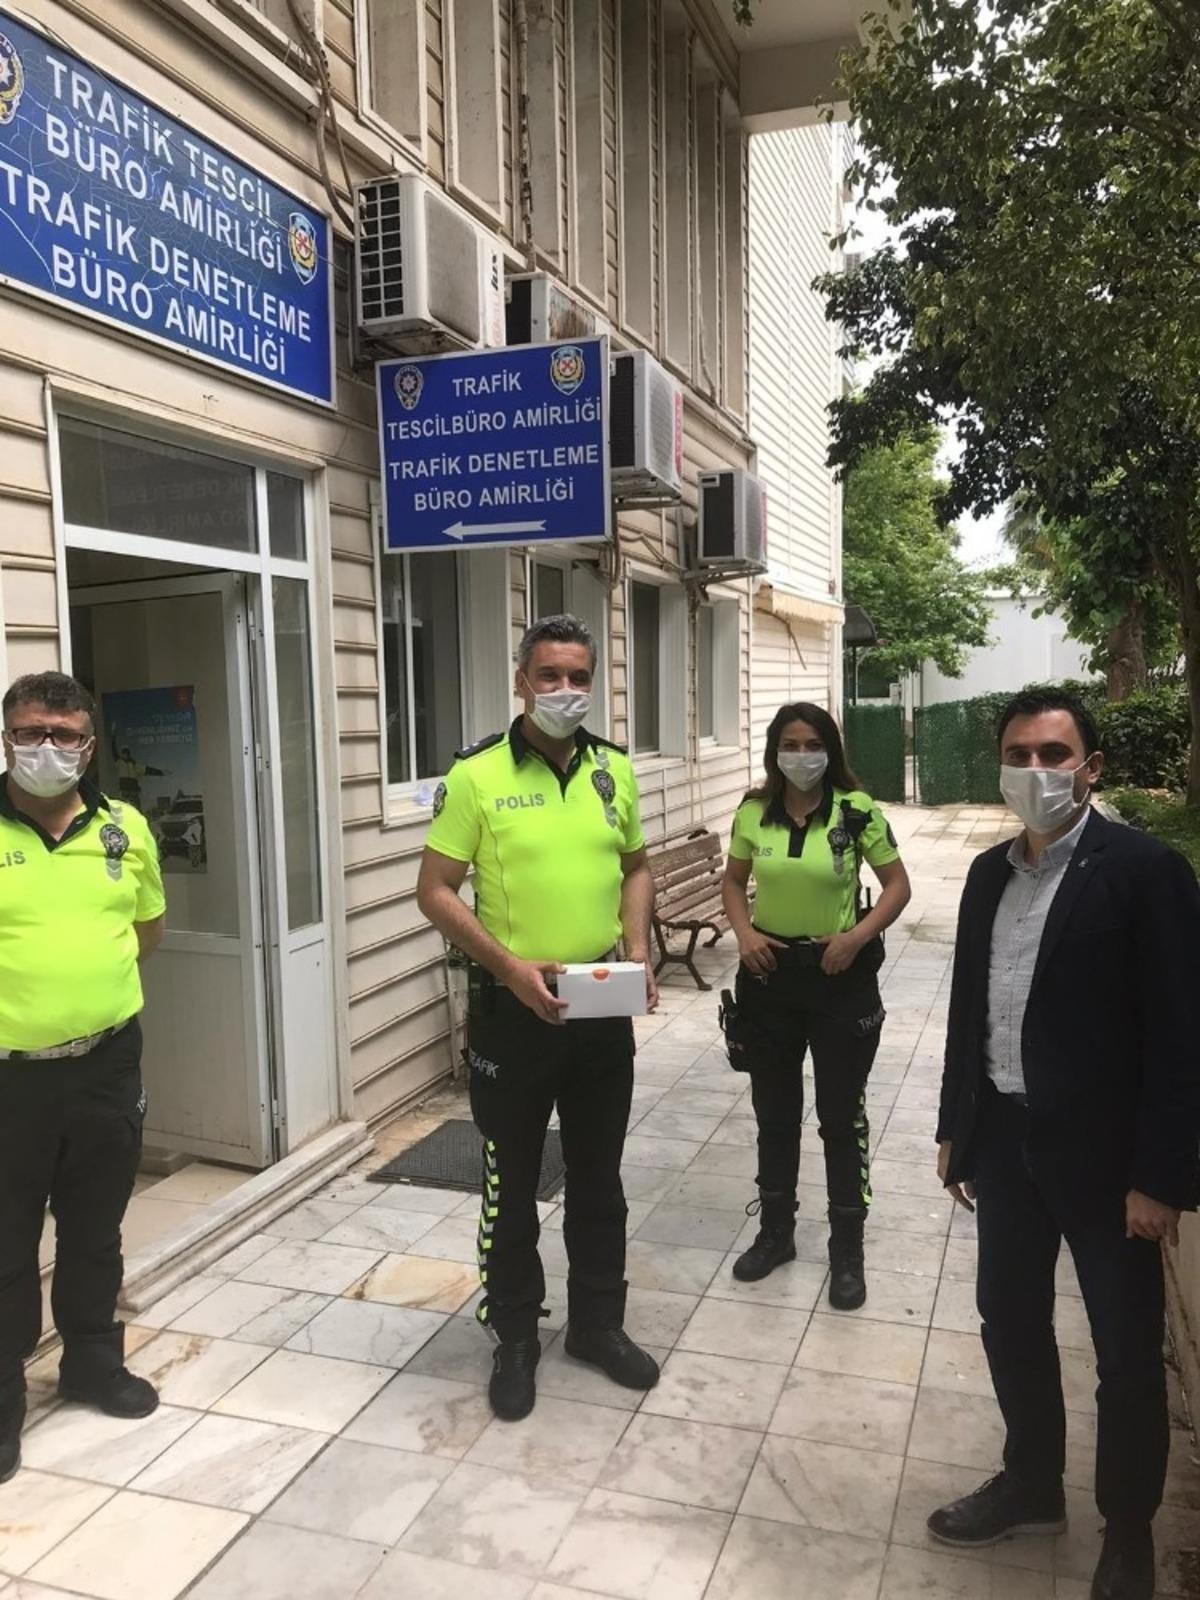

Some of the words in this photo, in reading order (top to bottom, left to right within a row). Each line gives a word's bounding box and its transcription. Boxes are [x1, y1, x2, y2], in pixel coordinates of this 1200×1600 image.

[46, 55, 174, 165] TRAFİK
[183, 139, 279, 228] TESCİL
[46, 114, 147, 200] BÜRO
[160, 180, 282, 274] AMİRLİĞİ
[0, 160, 138, 263] TRAFİK
[150, 236, 311, 343] DENETLEME
[52, 244, 153, 320] BÜRO
[165, 298, 285, 375] AMİRLİĞİ
[452, 369, 522, 397] TRAFİK
[513, 397, 600, 429] AMİRLİĞİ
[390, 453, 462, 480] TRAFİK
[469, 445, 599, 473] DENETLEME
[414, 488, 472, 511] BÜRO
[479, 477, 574, 506] AMİRLİĞİ
